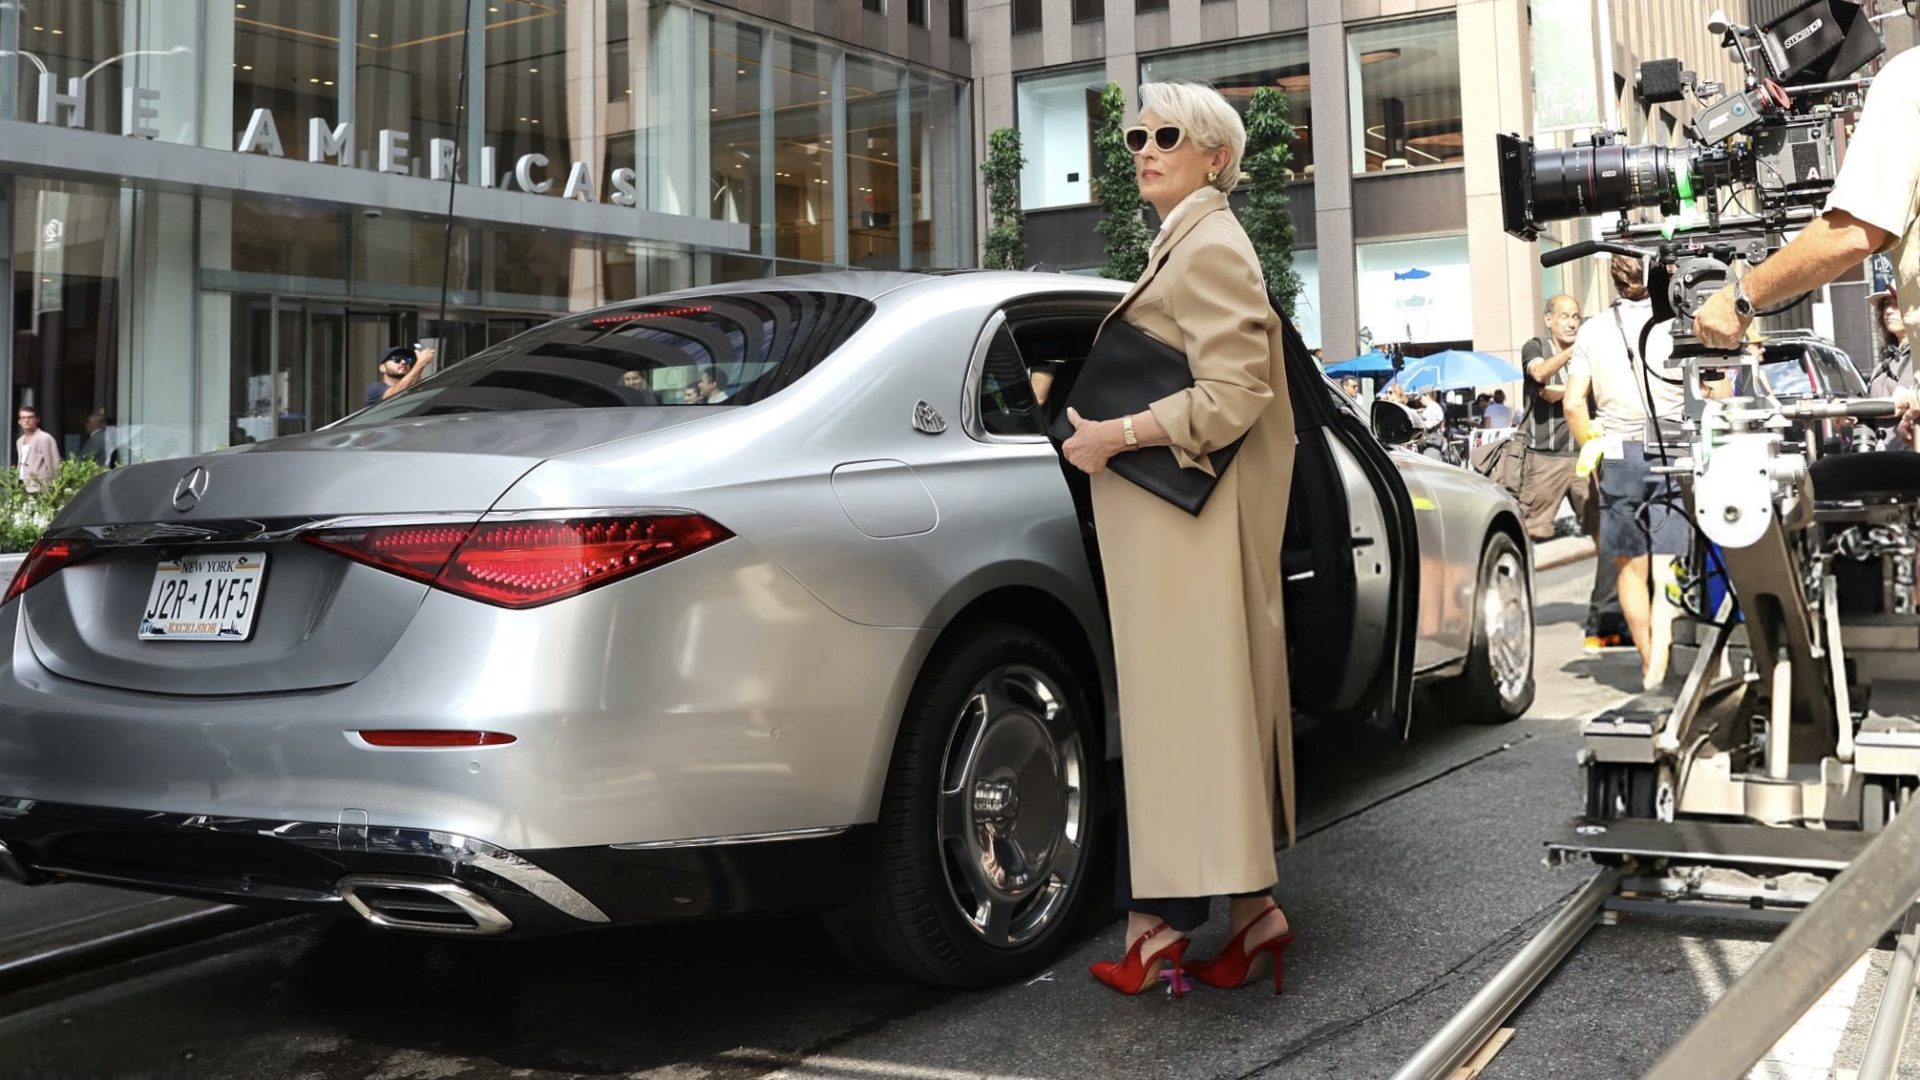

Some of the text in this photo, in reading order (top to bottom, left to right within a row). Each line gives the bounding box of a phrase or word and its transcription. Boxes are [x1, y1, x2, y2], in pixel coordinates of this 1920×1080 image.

[238, 108, 636, 206] AMERICAS
[1806, 167, 1820, 180] A
[181, 559, 235, 574] NEW YORK
[168, 621, 217, 634] EXCELSIOR
